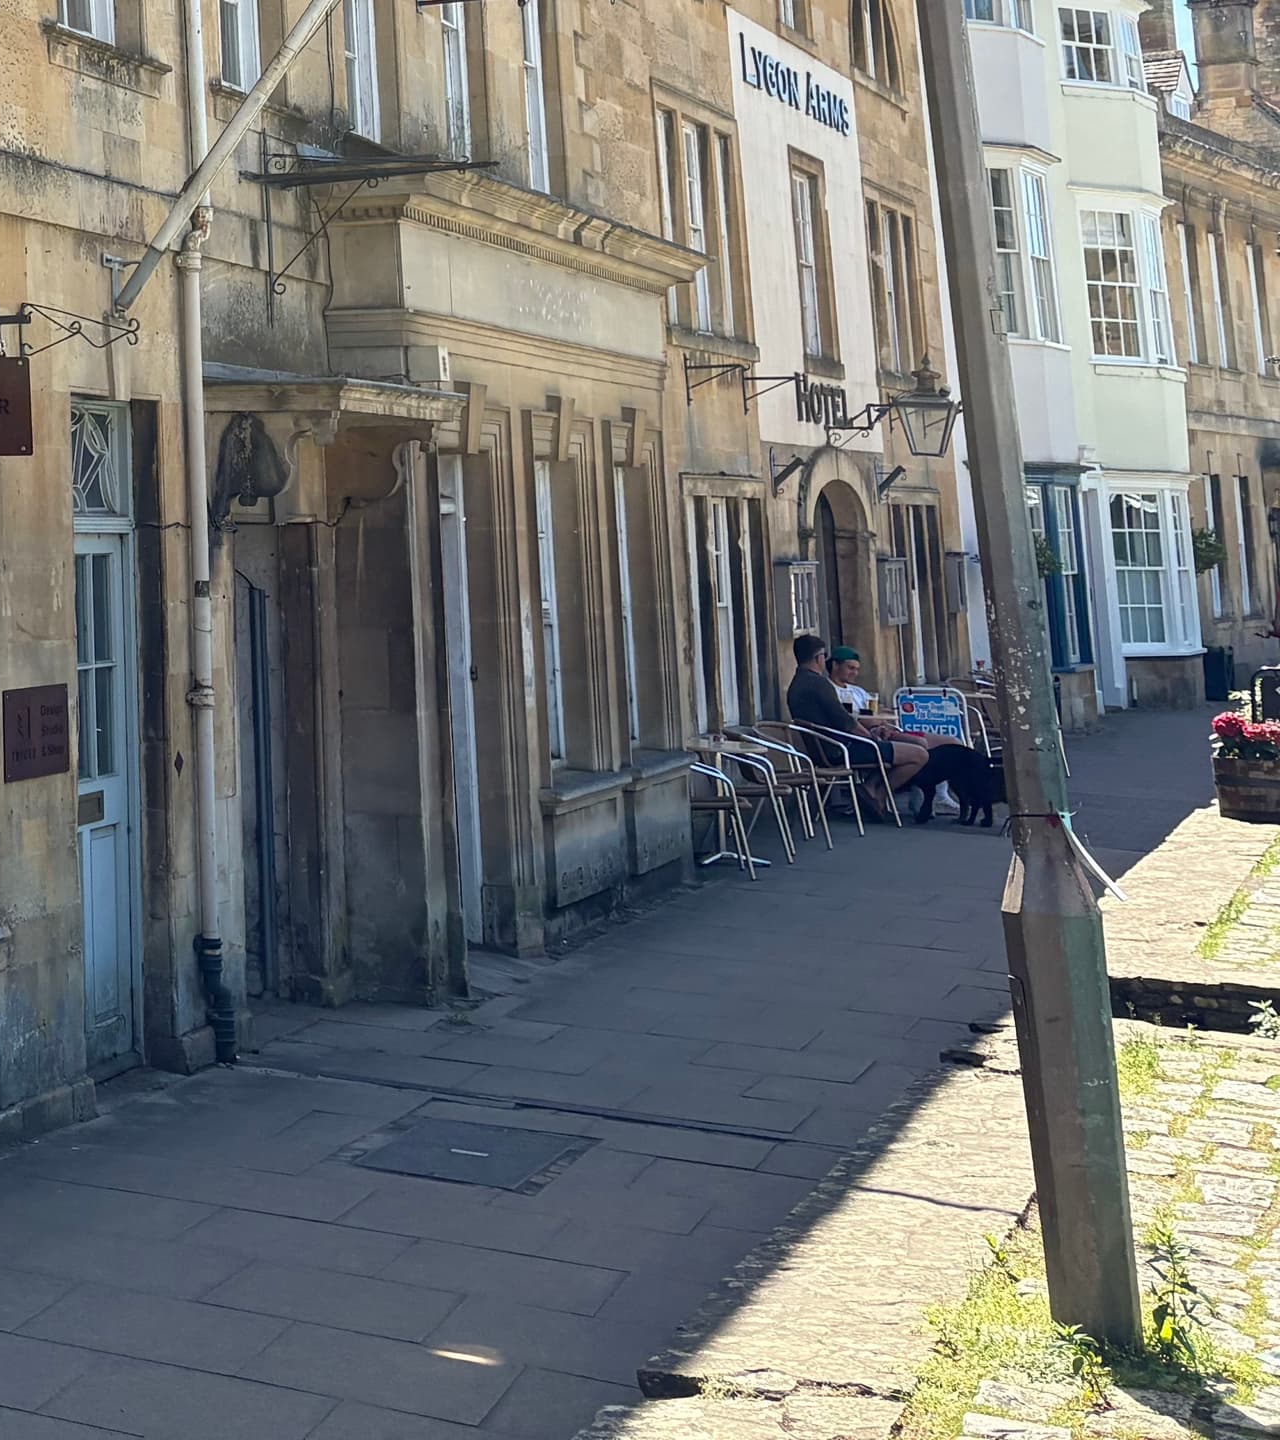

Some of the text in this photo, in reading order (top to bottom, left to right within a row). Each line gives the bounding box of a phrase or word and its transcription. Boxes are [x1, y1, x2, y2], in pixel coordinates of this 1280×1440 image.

[739, 31, 850, 137] LYGON ARMS
[794, 372, 853, 428] HOTEL
[904, 723, 958, 737] SERVED
